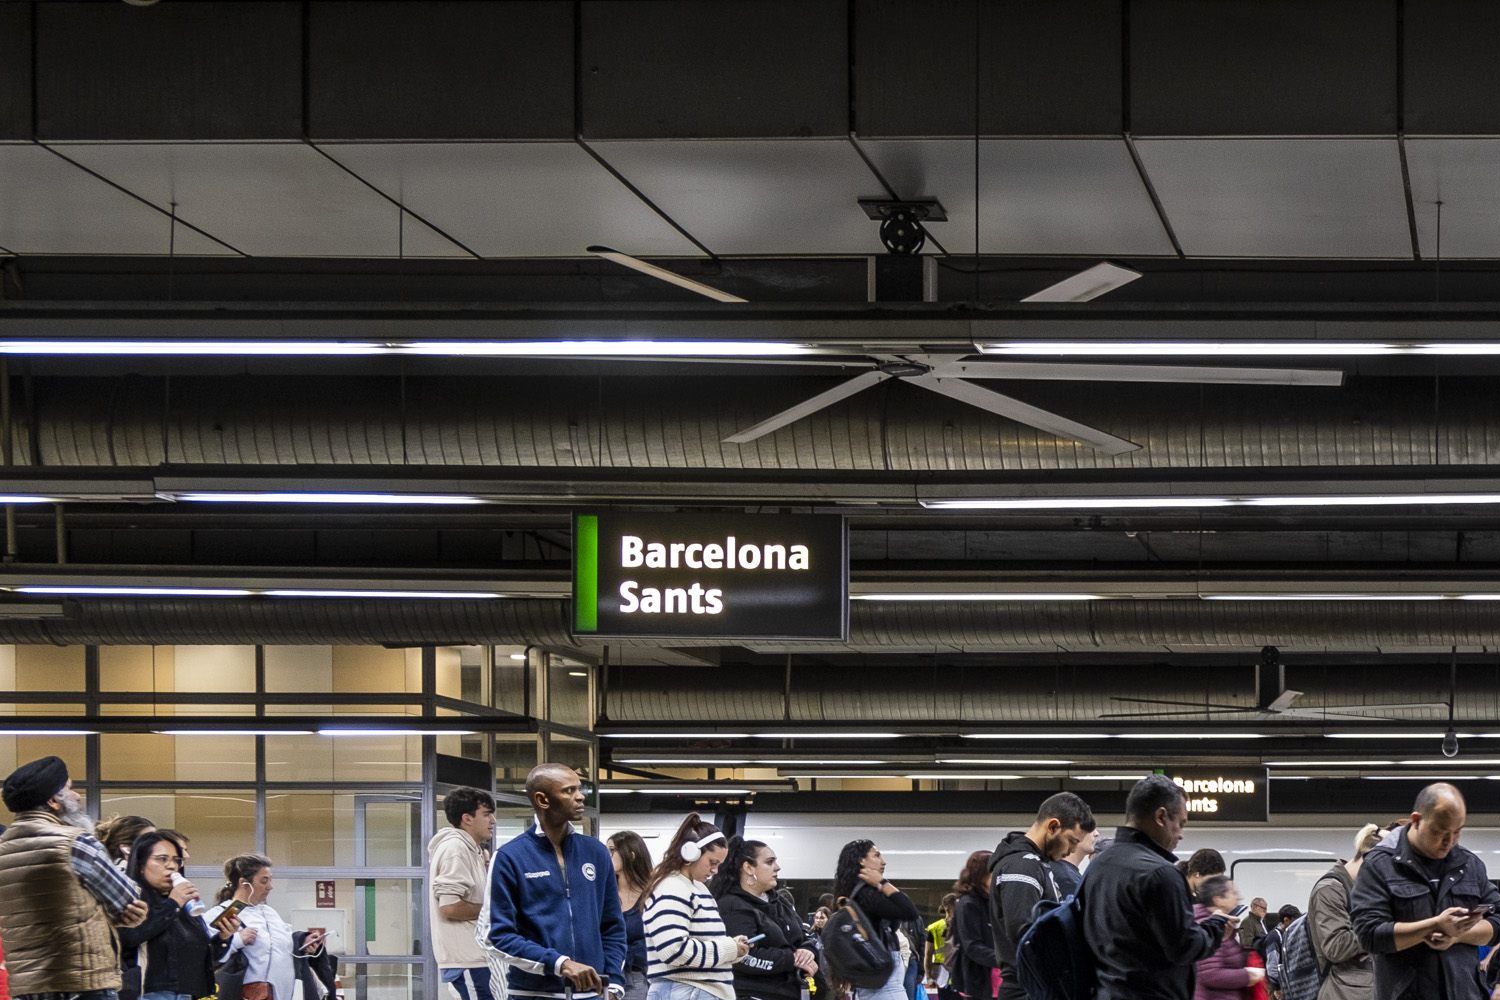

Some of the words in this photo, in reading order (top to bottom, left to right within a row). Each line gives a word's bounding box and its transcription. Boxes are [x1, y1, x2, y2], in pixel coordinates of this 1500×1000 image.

[621, 536, 809, 570] Barcelona
[619, 580, 723, 614] Sants
[1173, 777, 1255, 793] Barcelona
